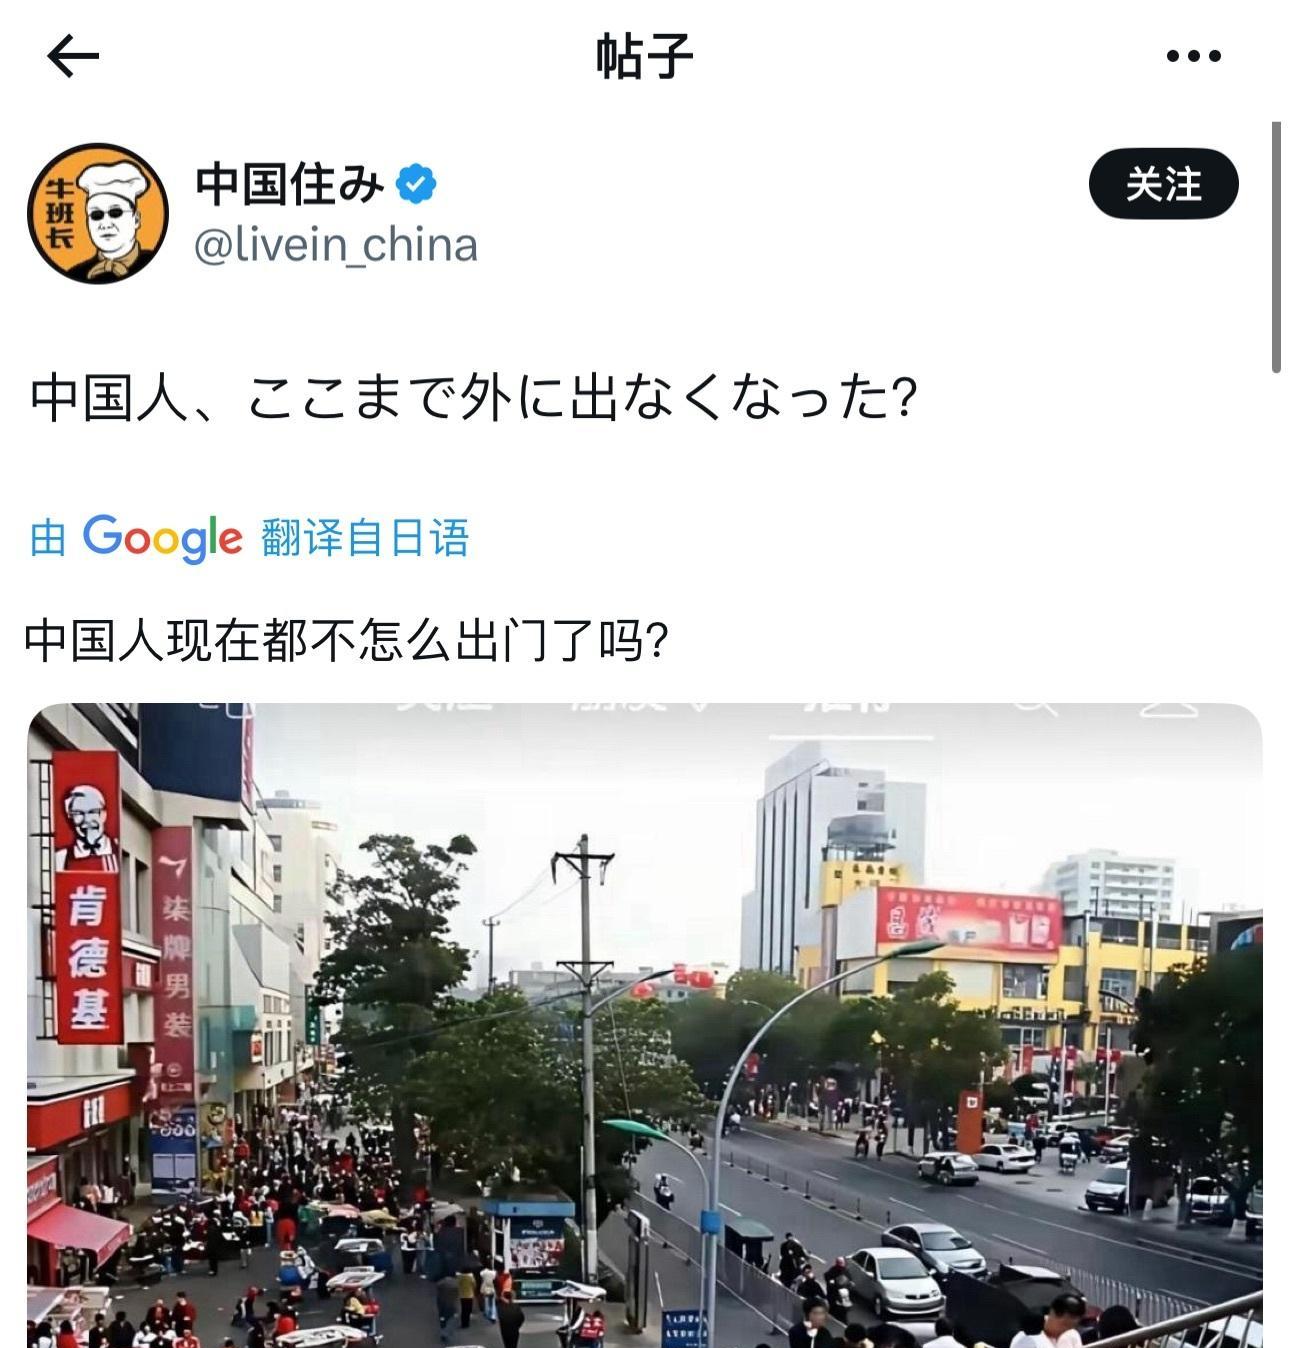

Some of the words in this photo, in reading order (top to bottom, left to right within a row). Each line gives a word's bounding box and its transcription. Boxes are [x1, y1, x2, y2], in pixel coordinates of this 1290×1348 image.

[597, 32, 693, 80] 帖子
[197, 161, 384, 206] 中国住み
[1127, 165, 1202, 202] 关注
[45, 178, 75, 249] 牛班长
[195, 224, 477, 268] @livein_china
[32, 371, 916, 422] 中国人、ここまで外に出なくなった?
[32, 518, 64, 557] 由
[83, 514, 243, 565] Google
[262, 517, 469, 557] 翻译自日语
[26, 617, 668, 662] 中国人现在都不怎么出门了吗?
[69, 884, 110, 1031] 肯德基
[162, 894, 192, 1038] 柒牌男装
